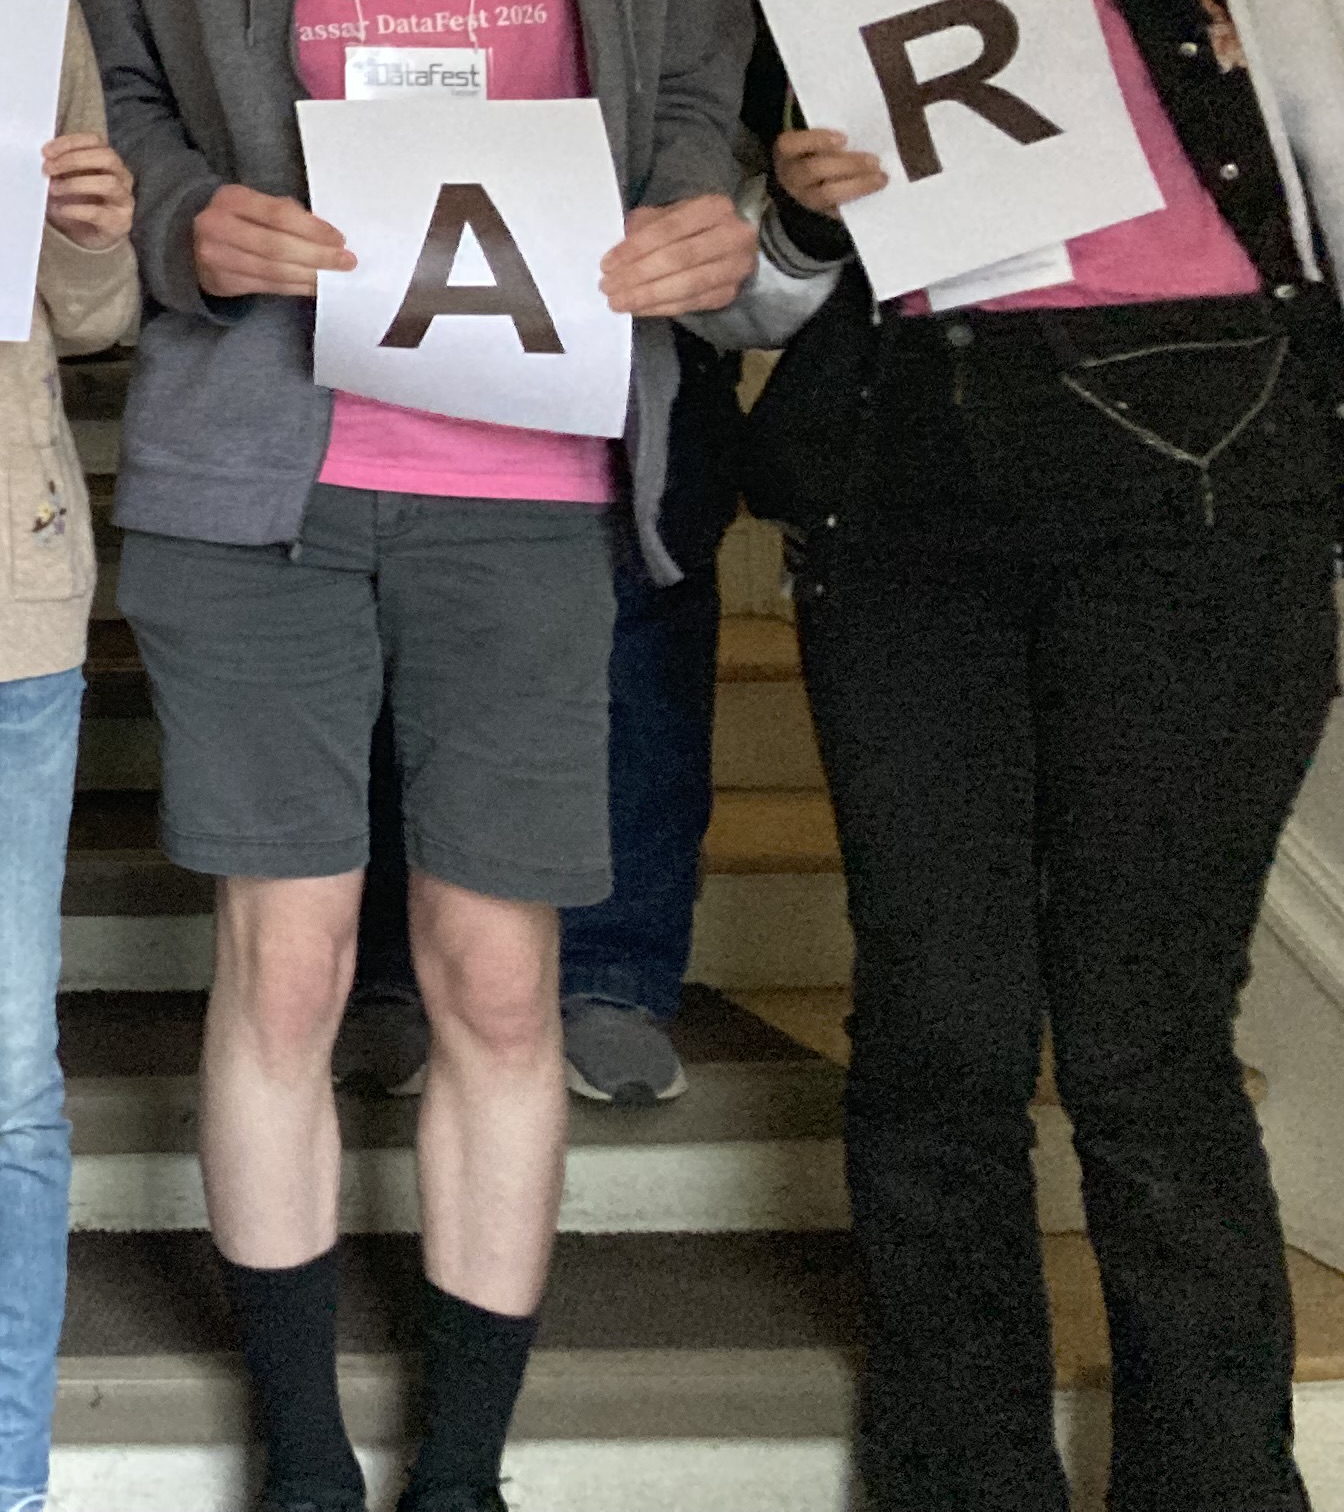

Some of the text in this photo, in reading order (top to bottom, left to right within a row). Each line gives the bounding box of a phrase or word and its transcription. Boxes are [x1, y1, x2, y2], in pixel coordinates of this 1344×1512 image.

[297, 3, 548, 40] assar DataFest 2026
[377, 183, 566, 355] A
